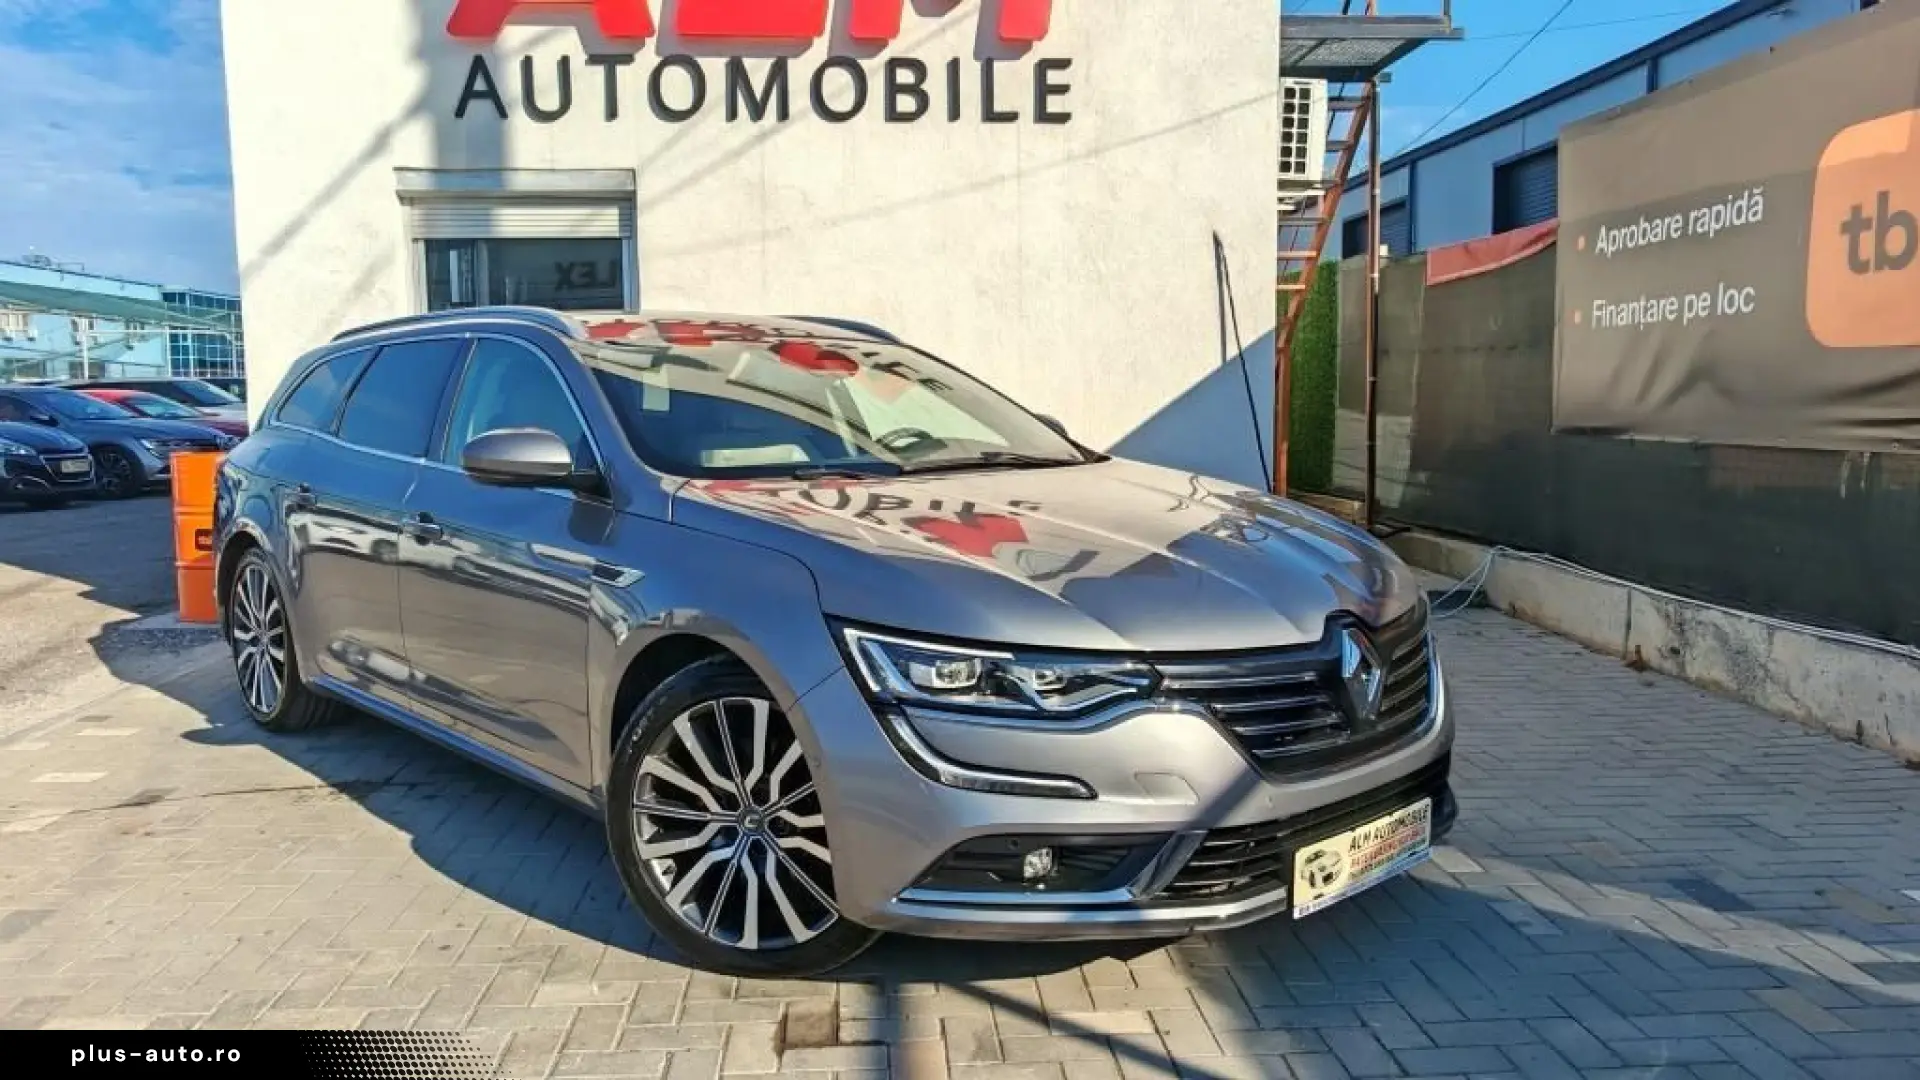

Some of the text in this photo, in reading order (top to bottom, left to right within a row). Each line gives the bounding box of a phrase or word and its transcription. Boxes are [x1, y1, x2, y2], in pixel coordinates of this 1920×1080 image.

[454, 54, 1073, 125] AUTOMOBILE
[1595, 186, 1766, 259] Aprobare rapidă
[1592, 282, 1756, 330] Finanțare pe loc
